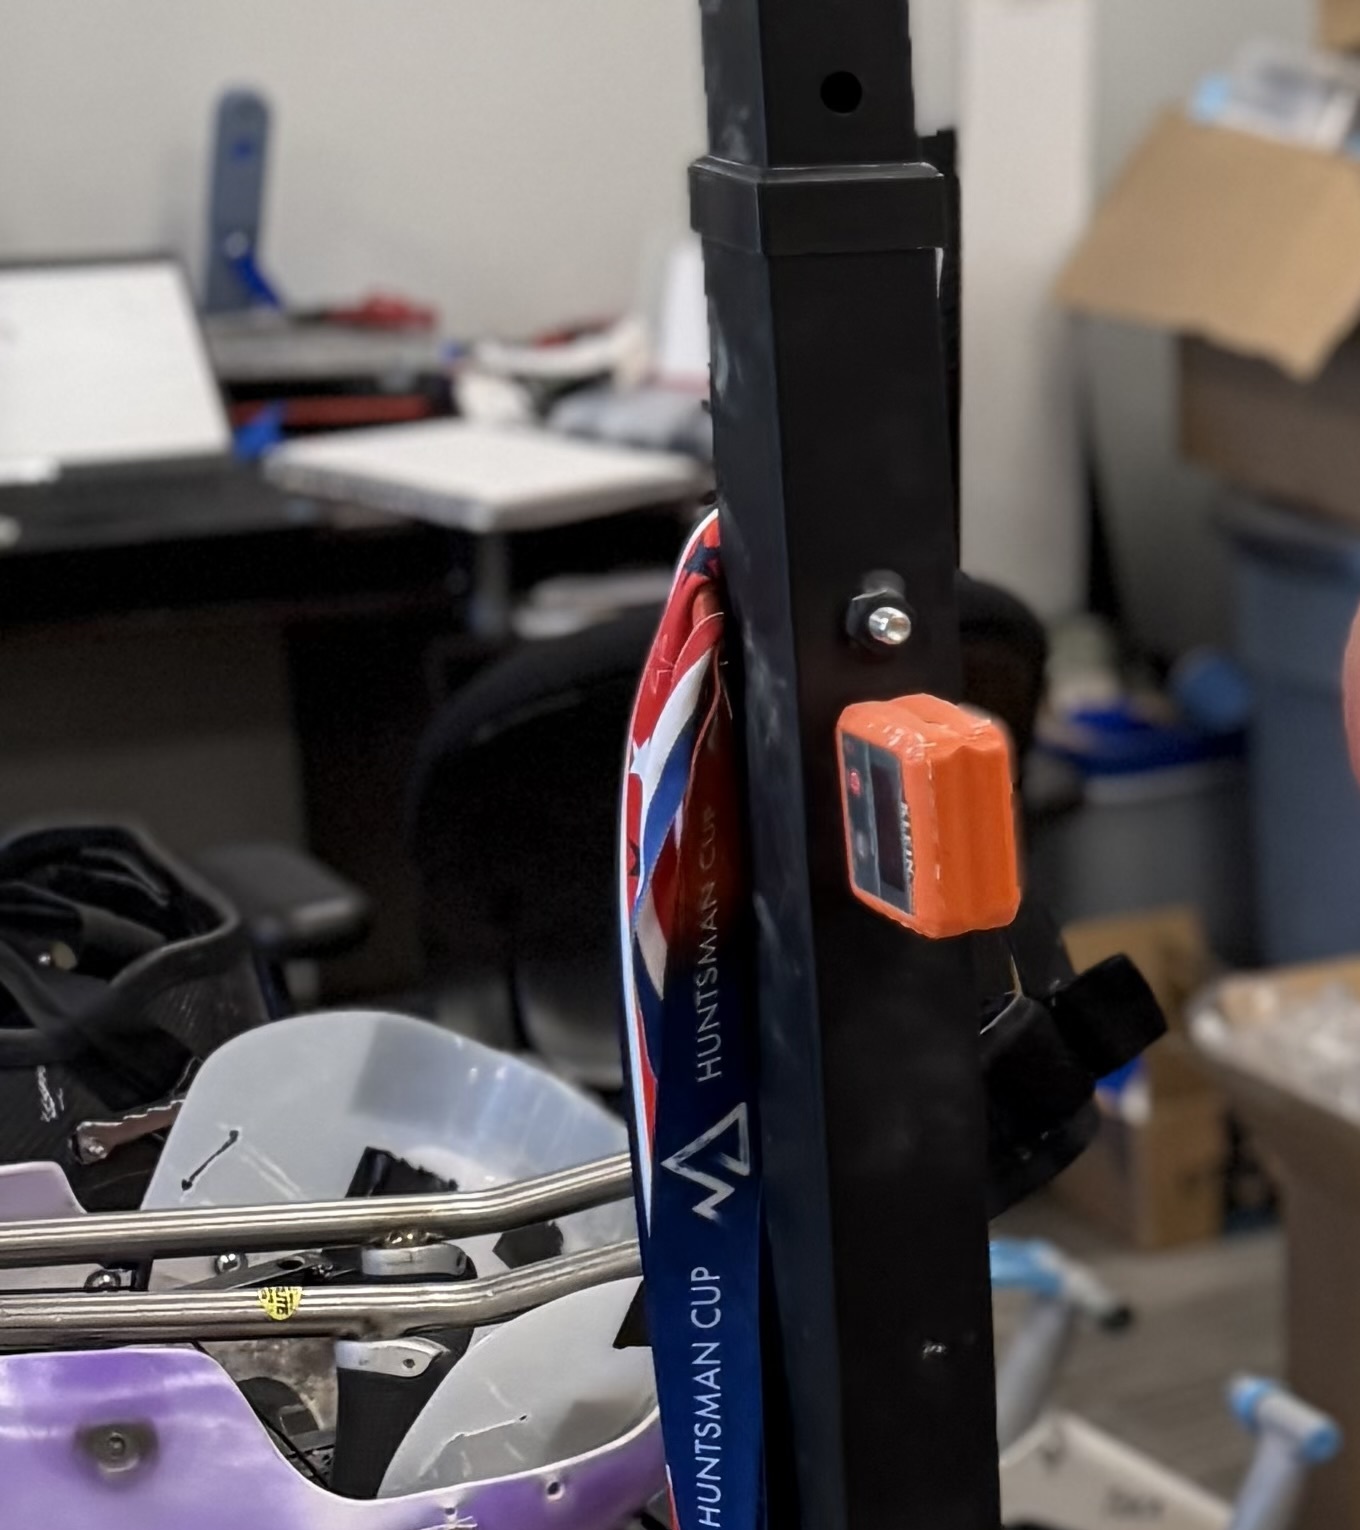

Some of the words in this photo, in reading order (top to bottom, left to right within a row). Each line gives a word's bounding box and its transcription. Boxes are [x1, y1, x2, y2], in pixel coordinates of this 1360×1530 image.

[696, 880, 722, 1084] HUNTSMAN
[690, 1265, 722, 1329] CUP
[691, 1341, 722, 1528] HUNTSMAN
